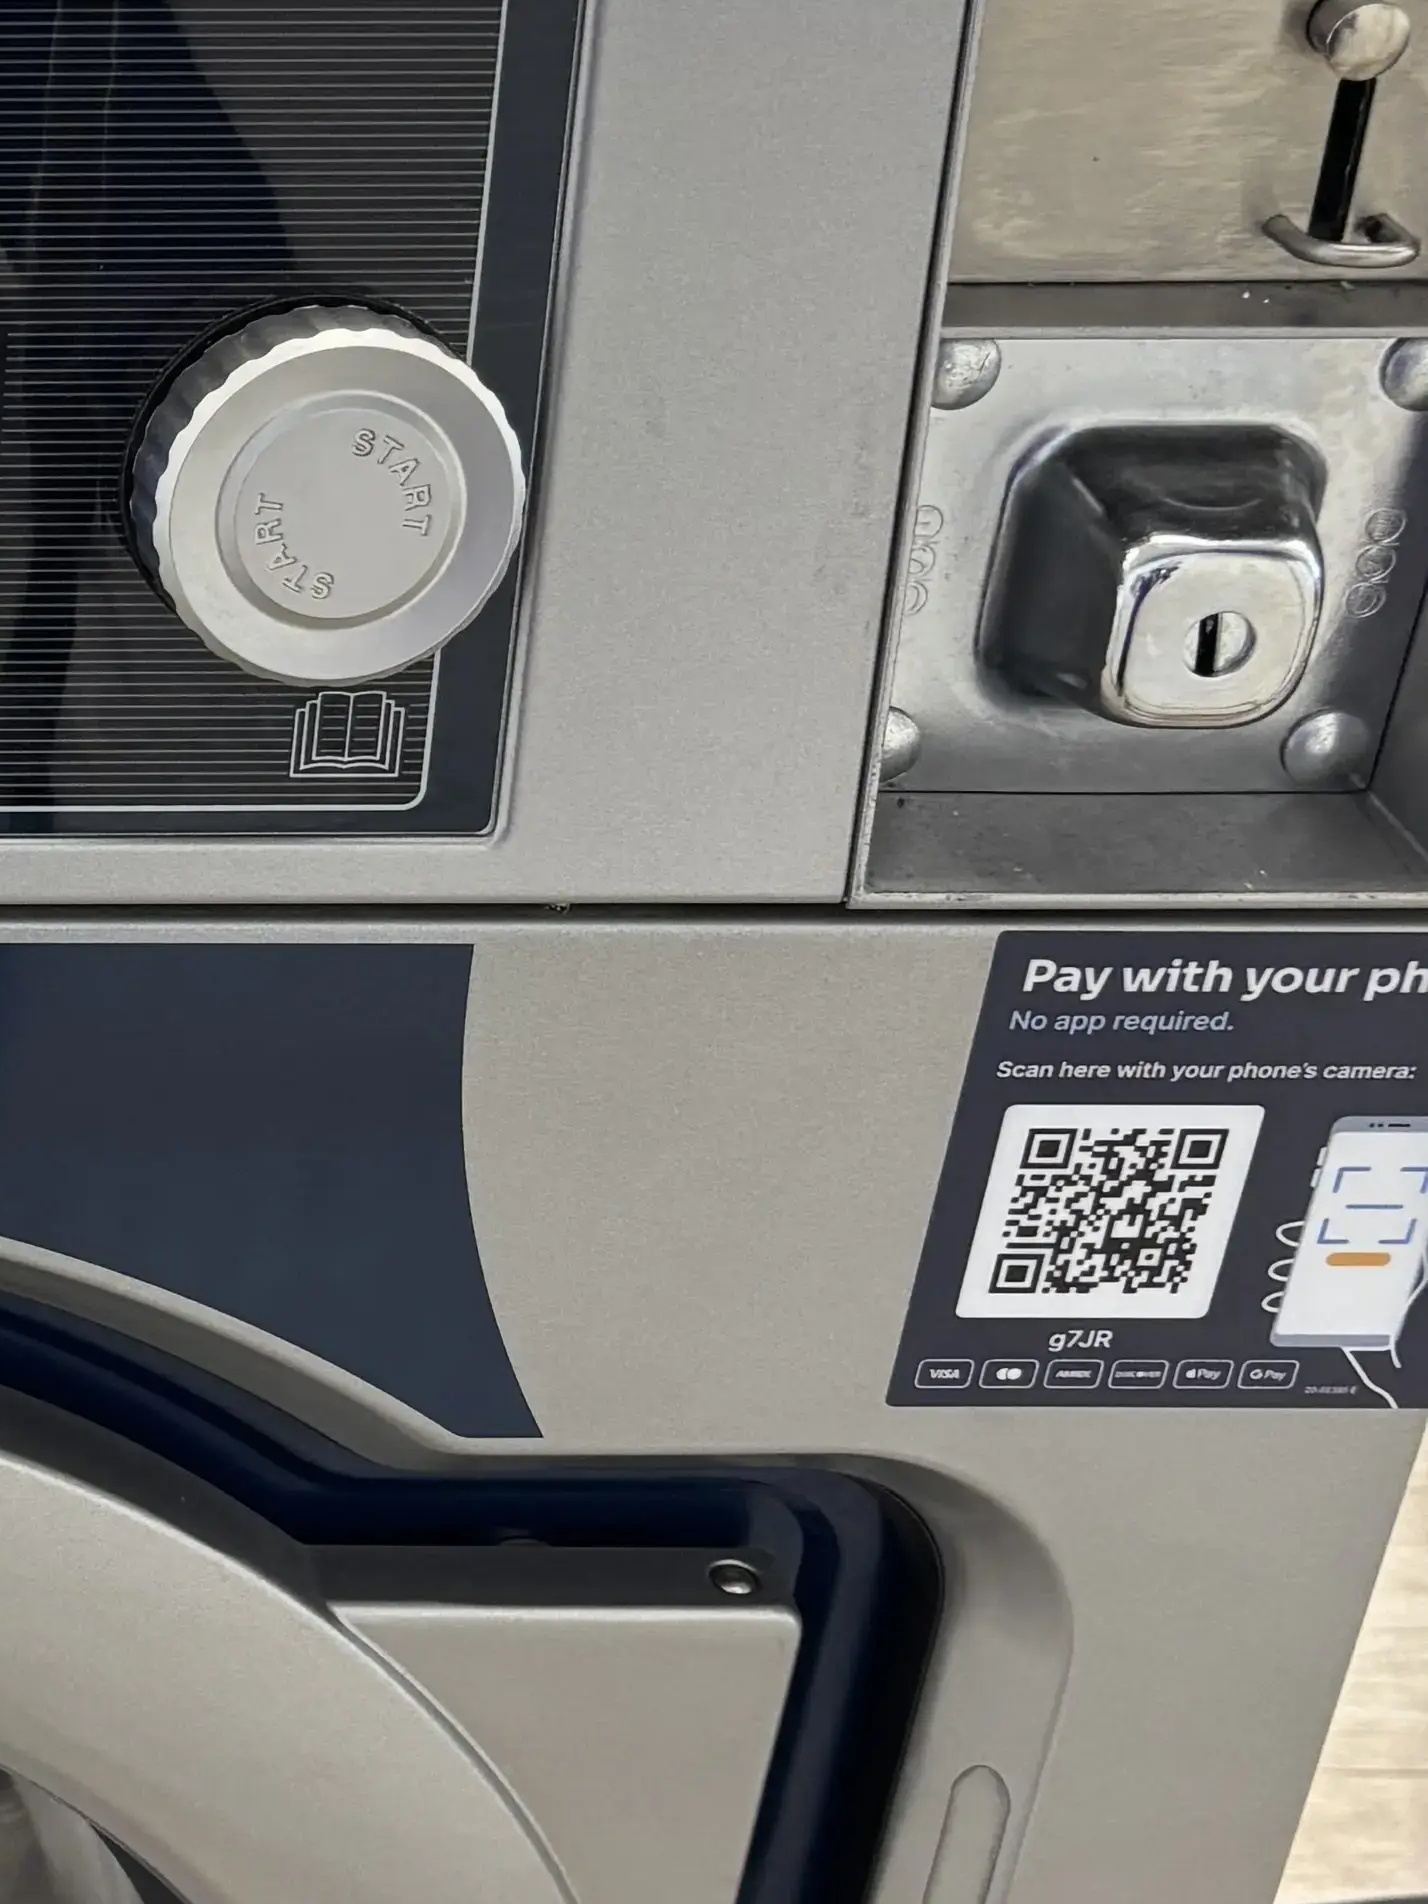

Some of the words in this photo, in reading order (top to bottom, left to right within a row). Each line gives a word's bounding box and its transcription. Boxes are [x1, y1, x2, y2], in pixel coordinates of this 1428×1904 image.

[351, 428, 433, 537] START
[255, 493, 335, 599] START
[1023, 958, 1112, 1000] Pay
[1123, 958, 1233, 994] with
[1241, 967, 1358, 1001] your
[1009, 1010, 1047, 1031] No
[1054, 1014, 1106, 1036] app
[1113, 1010, 1234, 1036] required.
[996, 1061, 1053, 1079] Scan
[1059, 1062, 1110, 1079] here
[1116, 1061, 1165, 1079] with
[1171, 1066, 1223, 1082] your
[1227, 1063, 1316, 1082] phone's
[1322, 1065, 1416, 1080] camera:
[1048, 1330, 1113, 1352] g7JR
[929, 1368, 960, 1379] VISA
[1197, 1369, 1222, 1380] Pay
[1264, 1369, 1286, 1381] Pay
